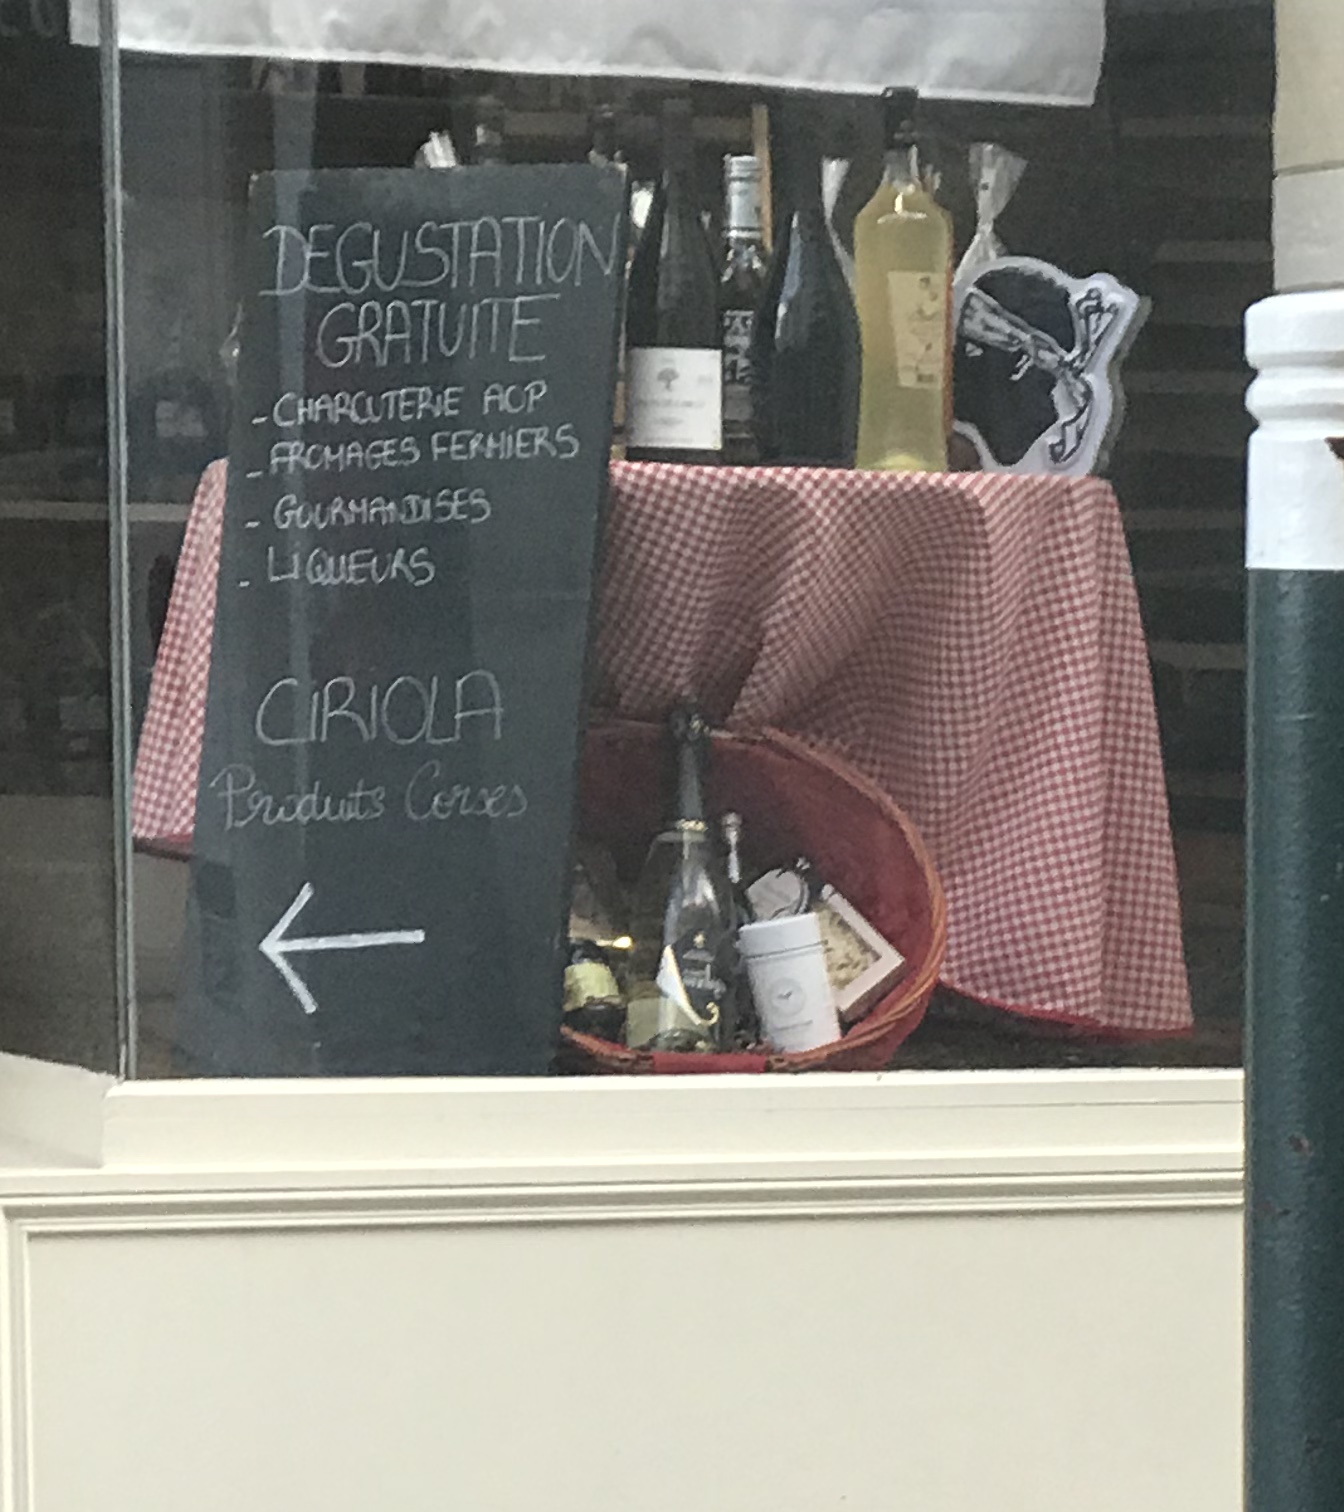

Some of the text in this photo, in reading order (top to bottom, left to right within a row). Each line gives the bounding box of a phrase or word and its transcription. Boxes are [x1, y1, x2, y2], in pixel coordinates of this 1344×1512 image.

[259, 212, 622, 297] DEGUSTATION
[317, 294, 560, 368] GRATUITE
[269, 436, 420, 475] FROMAGES
[255, 669, 504, 746] CIRIOLA
[209, 759, 529, 831] Produits Corses
